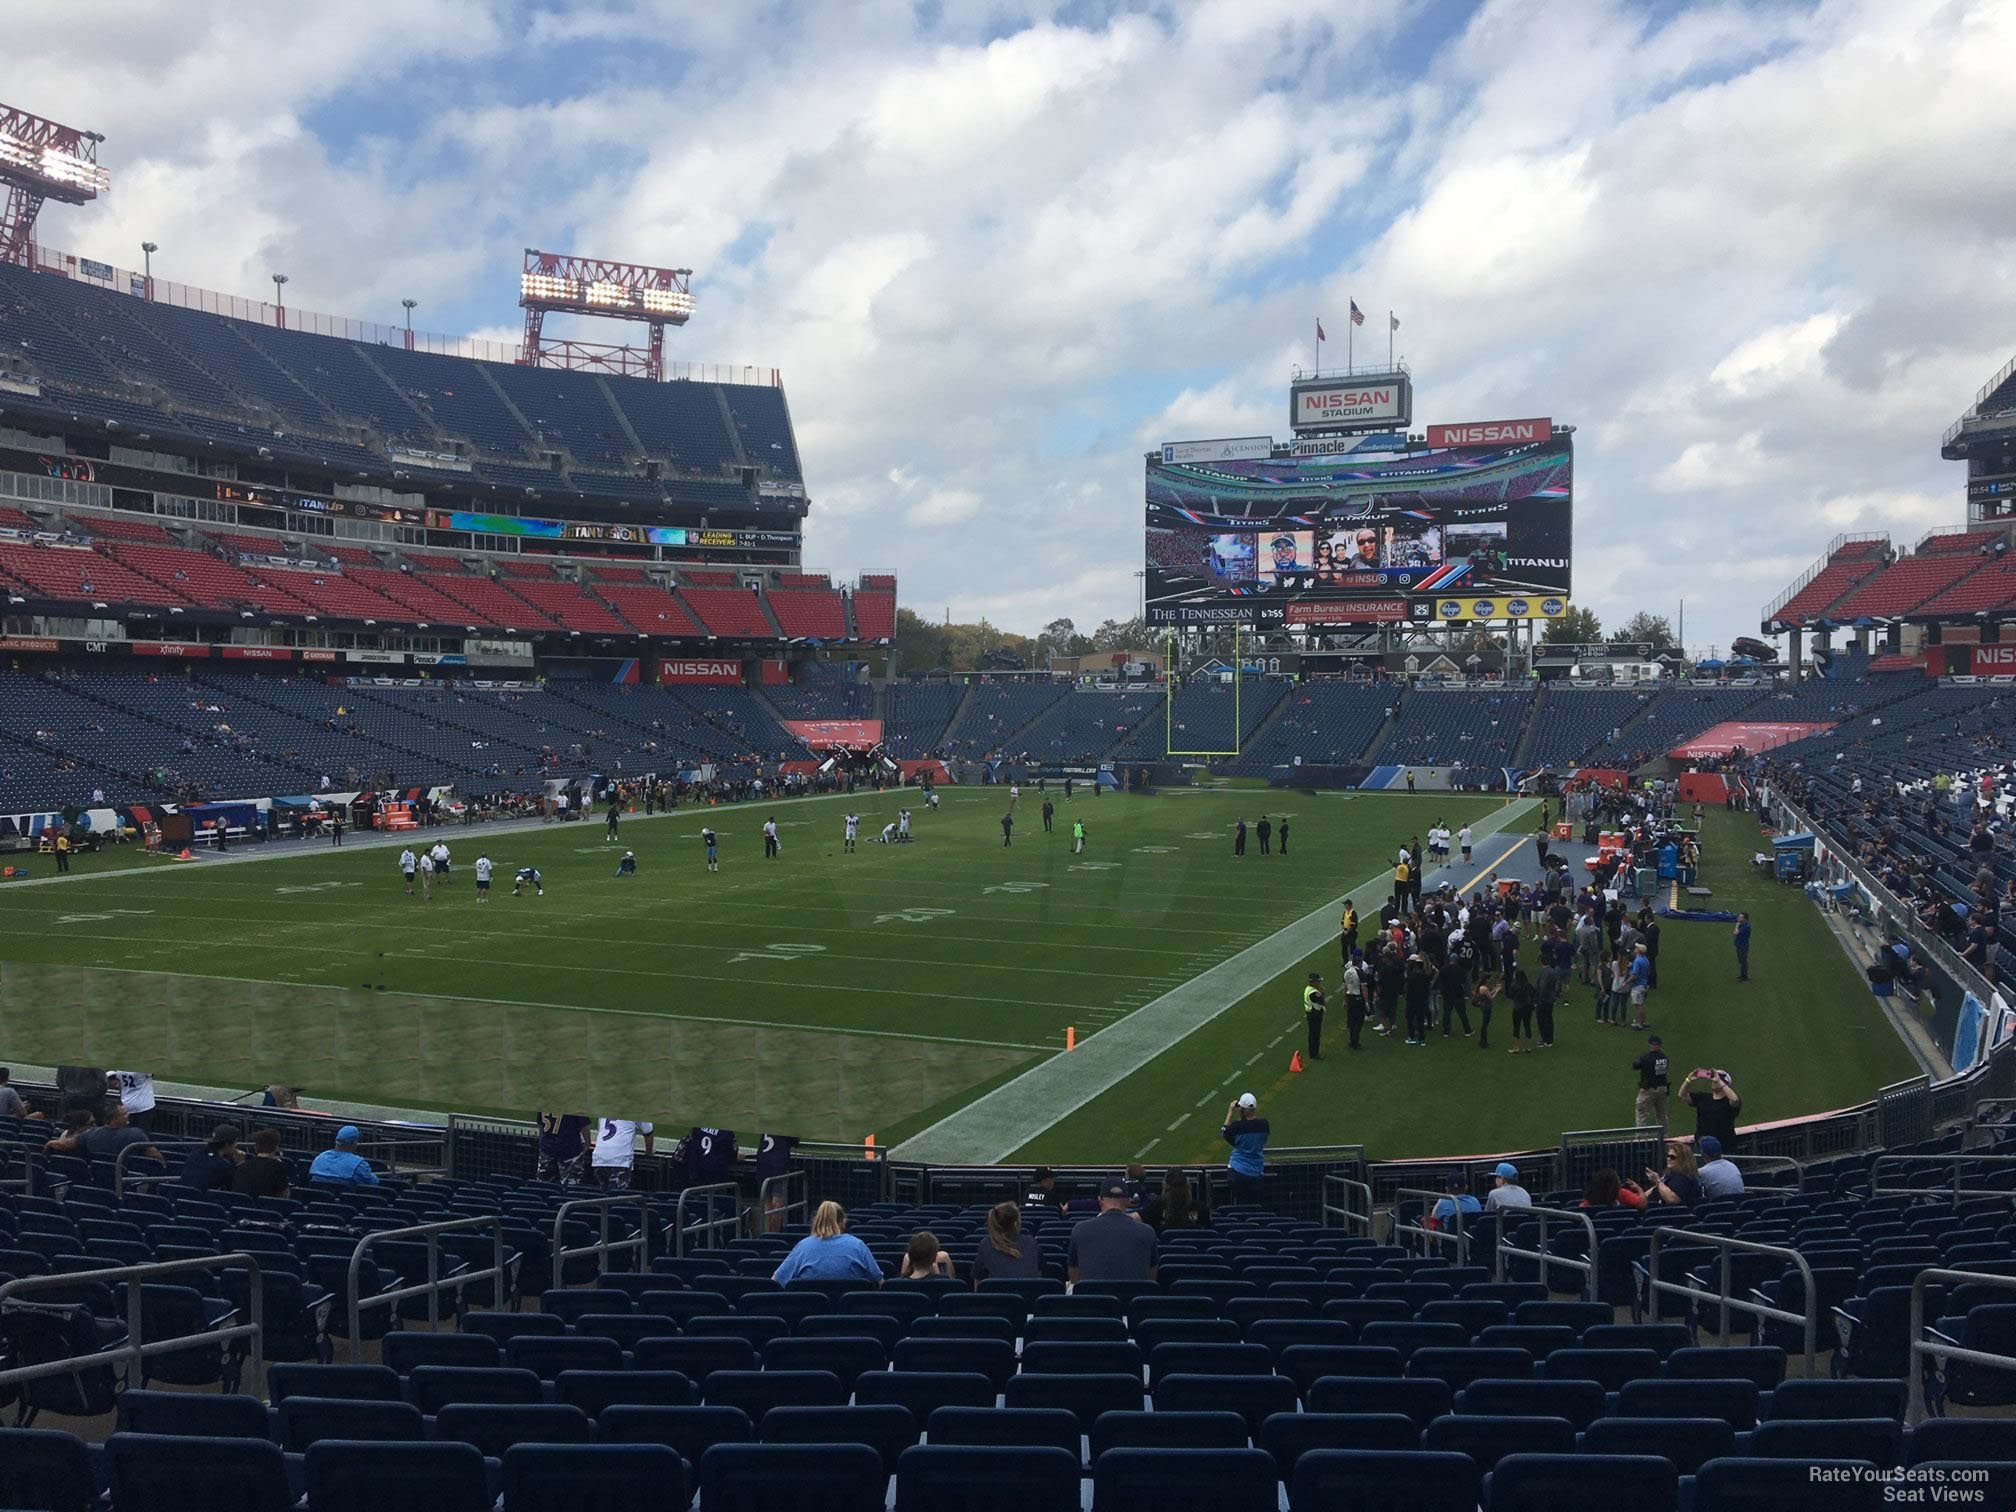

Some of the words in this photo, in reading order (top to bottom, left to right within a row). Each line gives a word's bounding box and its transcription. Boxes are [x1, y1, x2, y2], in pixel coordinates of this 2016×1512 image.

[1306, 391, 1390, 409] NISSAN
[1322, 407, 1373, 417] STADIUM
[1444, 425, 1533, 443] NISSAN
[1292, 440, 1345, 454] Pinnacle
[702, 531, 732, 539] LEADING
[699, 538, 736, 546] RECEIVERS
[1152, 608, 1176, 620] THE
[1180, 608, 1253, 620] TENNESSEAN
[1288, 606, 1312, 614] Farm
[1313, 604, 1344, 613] Bureau
[1346, 602, 1404, 613] INSURANCE
[1441, 603, 1460, 616] Kroger
[1474, 602, 1493, 615] Kroger
[1508, 601, 1528, 615] Kroger
[1542, 600, 1562, 615] Kroger
[86, 642, 107, 652] CMT
[160, 645, 184, 655] xfinity
[1976, 648, 2016, 664] NIS
[664, 663, 737, 676] NISSAN
[738, 943, 827, 961] 10
[1460, 946, 1473, 959] 20
[122, 1074, 136, 1088] 52
[701, 1136, 712, 1156] 9
